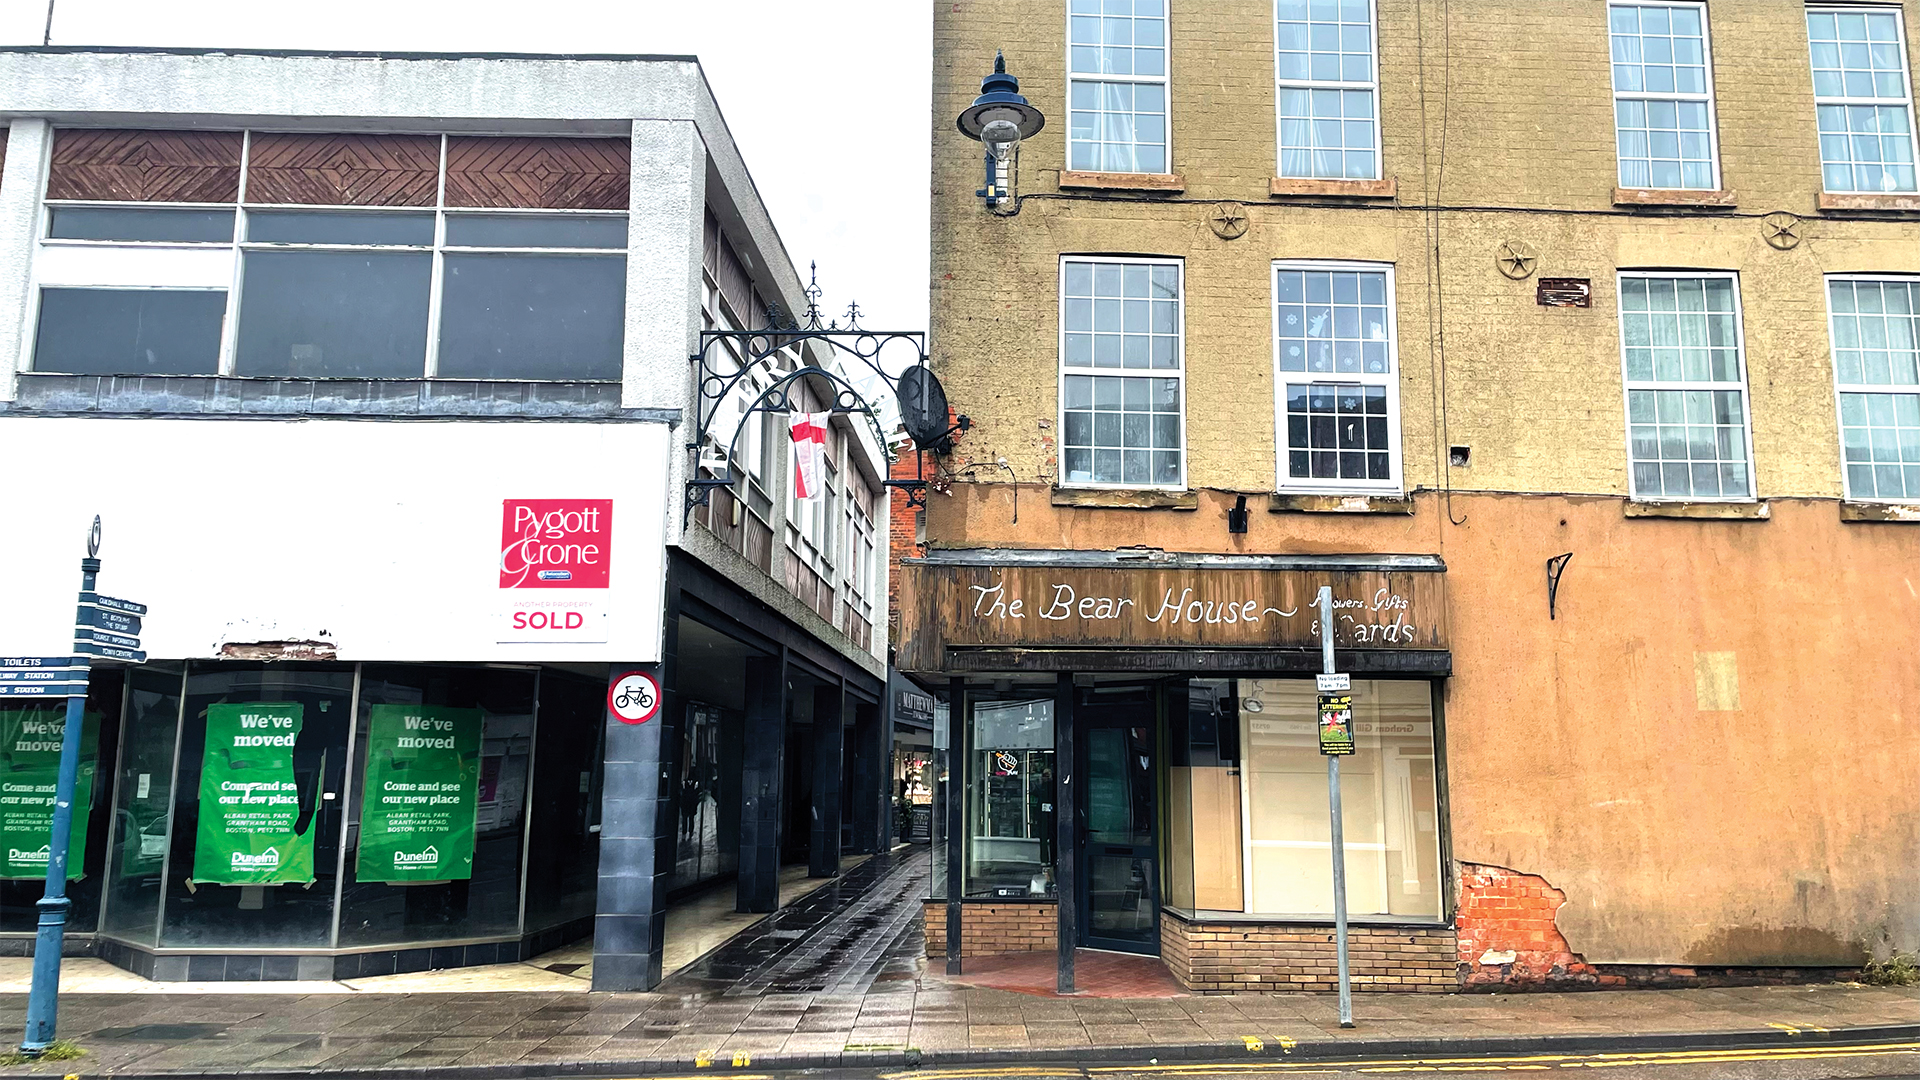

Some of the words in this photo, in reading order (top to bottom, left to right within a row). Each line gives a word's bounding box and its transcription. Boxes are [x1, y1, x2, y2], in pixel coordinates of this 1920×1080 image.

[514, 505, 600, 539] Pygott
[500, 521, 541, 588] &
[521, 538, 599, 565] Crone
[968, 582, 1025, 619] The
[1039, 584, 1134, 620] Bear
[1145, 587, 1258, 624] House
[1371, 588, 1408, 611] Gifts
[513, 611, 583, 629] SOLD
[4, 658, 42, 667] TOILETS
[24, 672, 55, 680] STATION
[14, 686, 45, 694] STATION
[240, 714, 293, 728] We've
[404, 716, 454, 731] We've
[22, 721, 65, 735] We've
[15, 740, 63, 752] move
[233, 733, 295, 747] moved
[398, 736, 455, 749] moved
[2, 782, 34, 793] Come
[35, 782, 57, 793] and
[384, 781, 416, 791] Come
[418, 782, 439, 791] and
[441, 783, 461, 791] see
[219, 796, 240, 804] our
[382, 796, 402, 804] our
[404, 796, 428, 804] new
[429, 794, 460, 806] place
[9, 848, 50, 859] Dunelm
[231, 850, 277, 864] Dunelm
[394, 849, 437, 862] Dunelm
